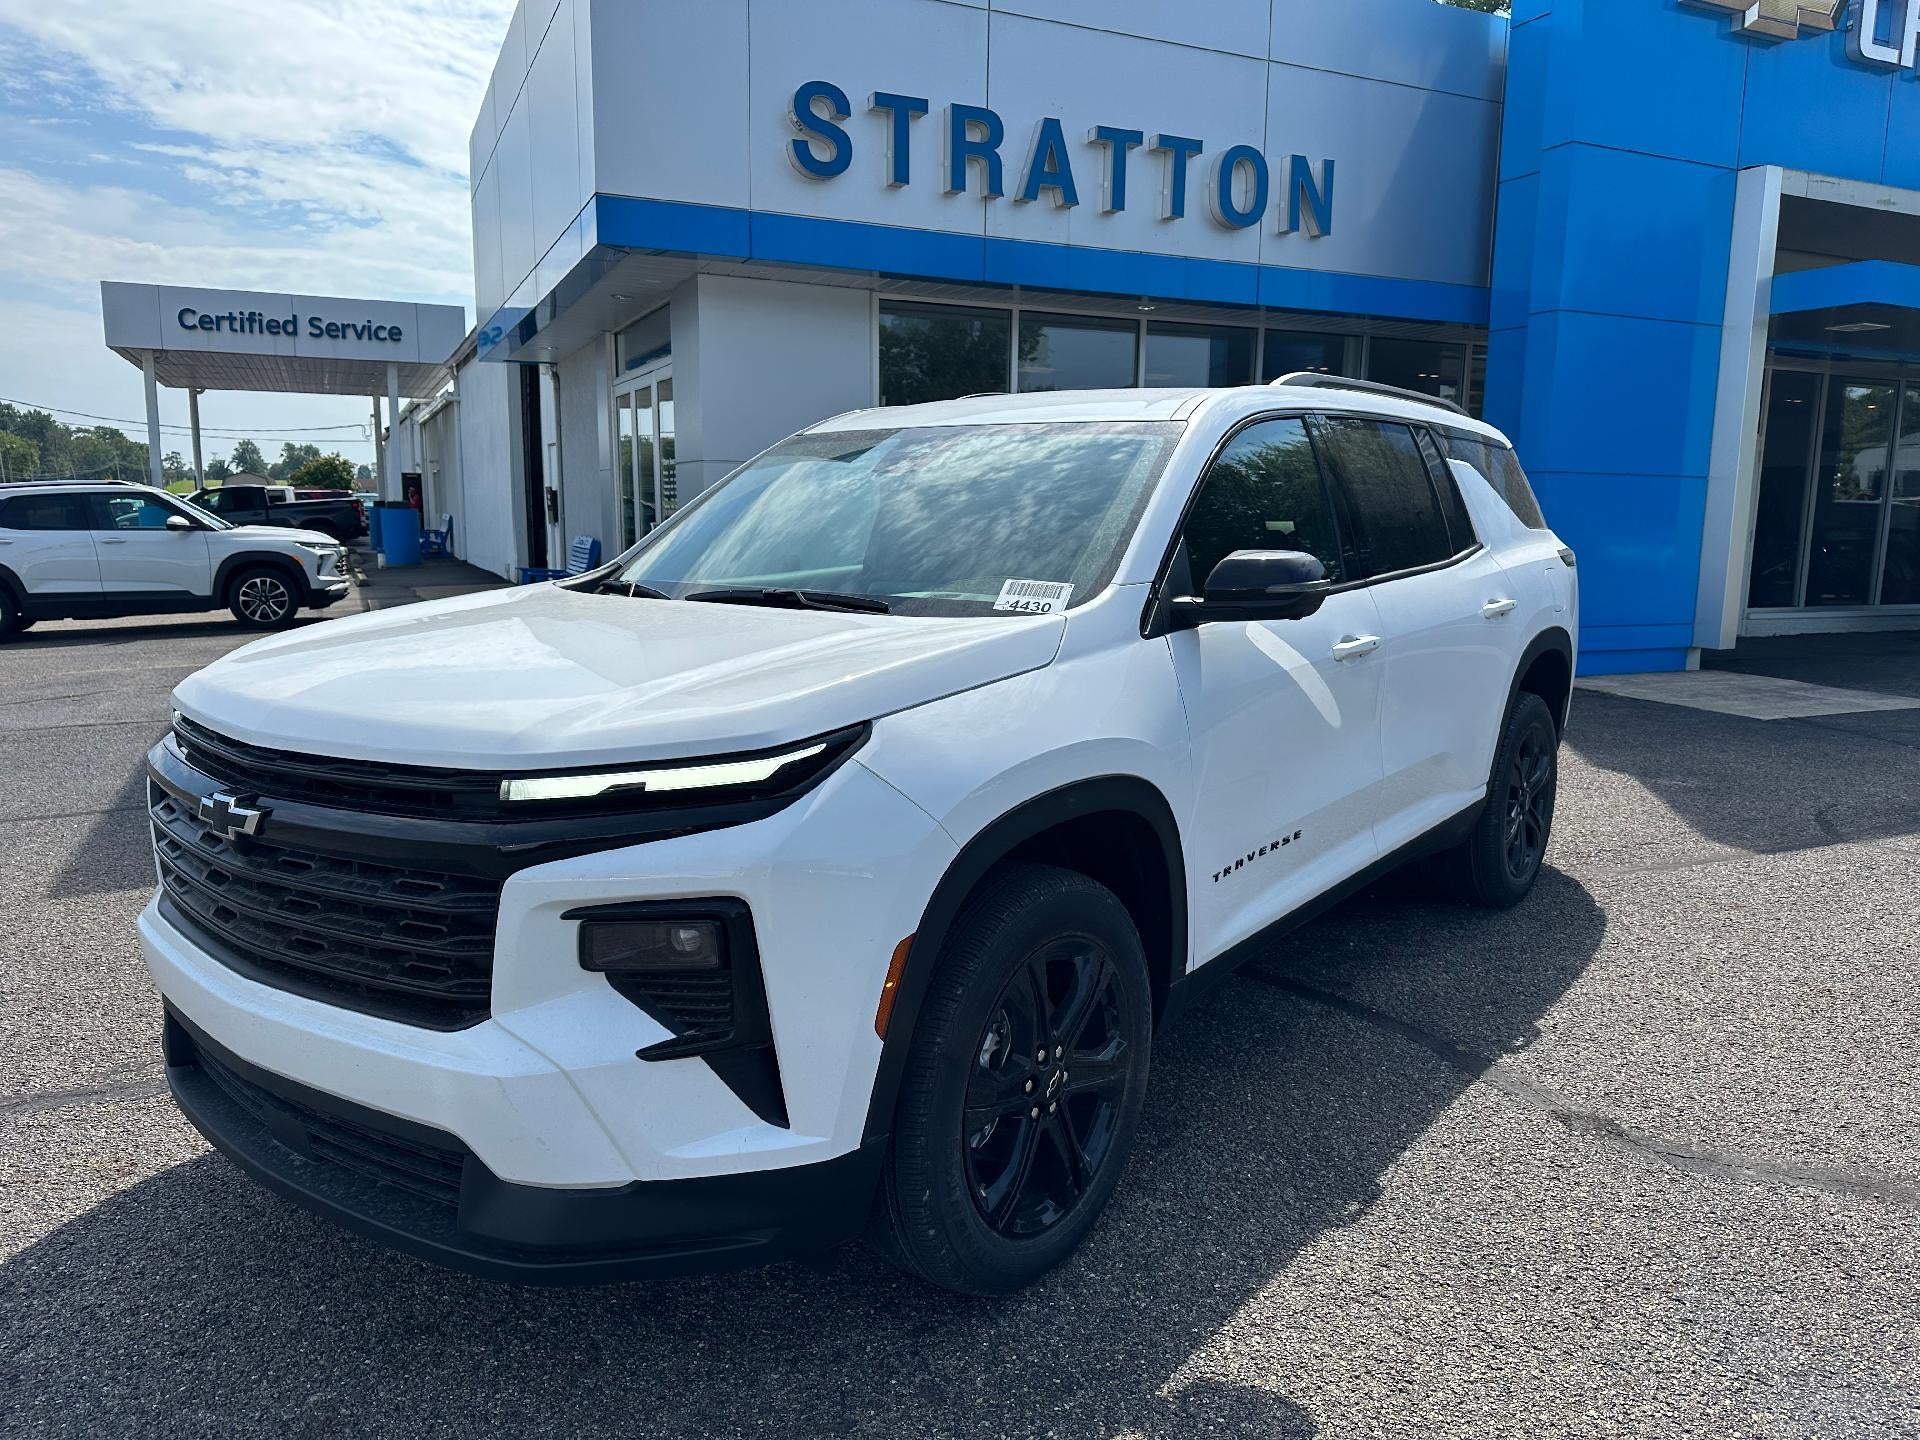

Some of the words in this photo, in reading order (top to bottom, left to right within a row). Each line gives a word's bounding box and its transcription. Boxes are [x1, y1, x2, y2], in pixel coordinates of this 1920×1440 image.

[787, 80, 1335, 238] STRATTON
[178, 307, 298, 336] Certified
[308, 316, 402, 342] Service
[1009, 599, 1052, 613] 4430
[1212, 829, 1302, 883] TRAVERSE
